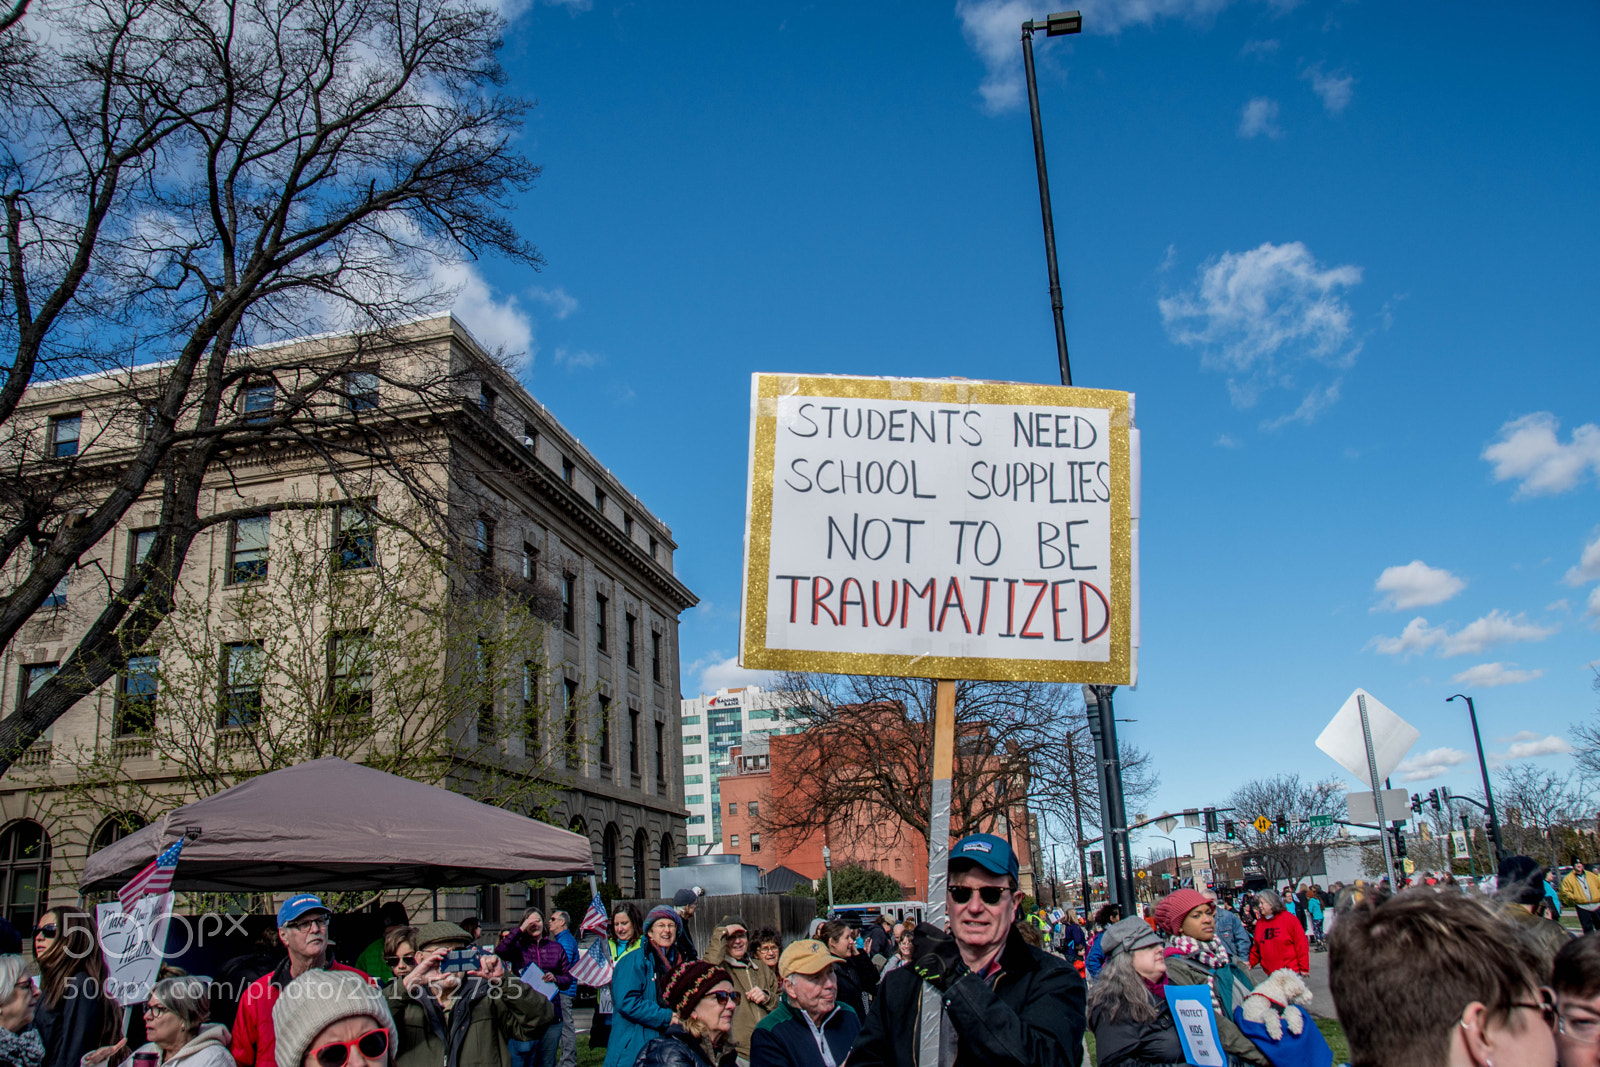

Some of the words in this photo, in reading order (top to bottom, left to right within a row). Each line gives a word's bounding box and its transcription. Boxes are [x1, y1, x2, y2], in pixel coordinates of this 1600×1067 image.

[788, 404, 982, 447] STUDENTS
[1013, 411, 1098, 450] NEED
[784, 458, 937, 500] SCHOOL
[967, 460, 1111, 503] SUPPLIES
[827, 513, 926, 564] NOT
[949, 520, 1002, 567] TO
[1037, 519, 1098, 571] BE
[776, 574, 1111, 644] TRAUMATIZED
[1180, 1008, 1203, 1018] PROTECT
[1189, 1024, 1203, 1034] KIDS
